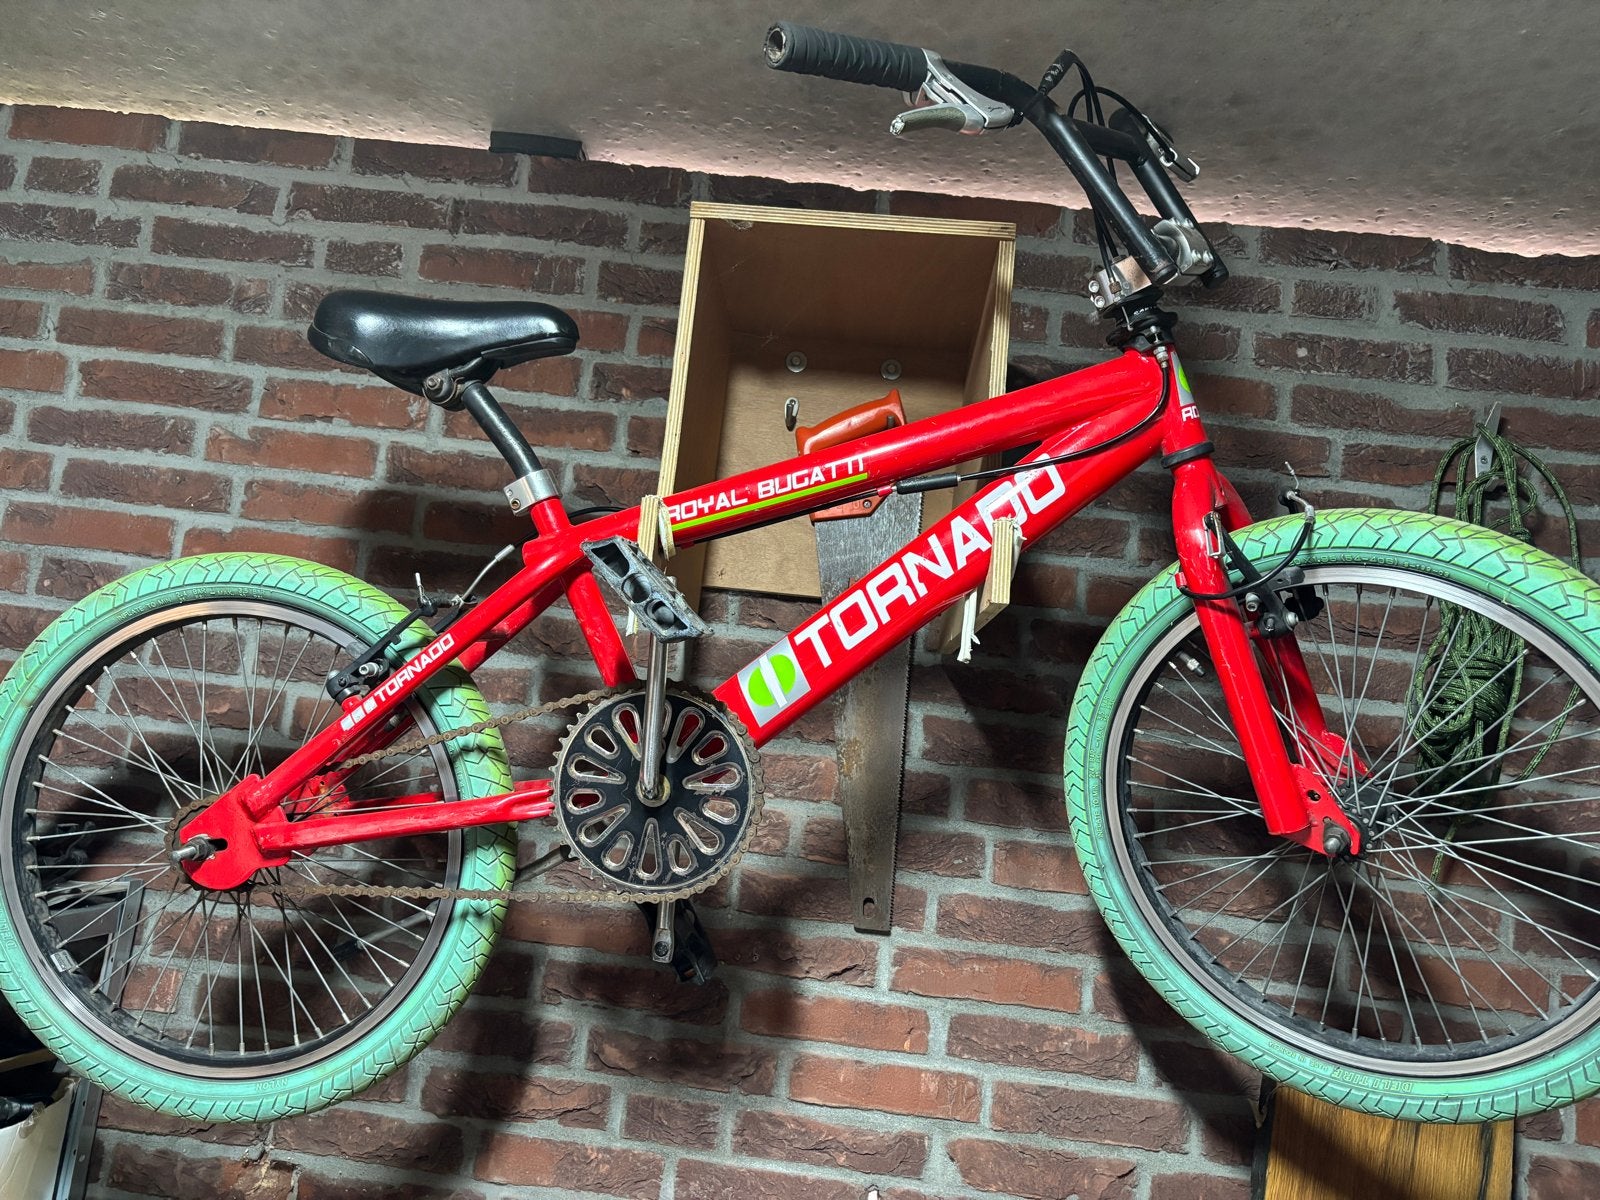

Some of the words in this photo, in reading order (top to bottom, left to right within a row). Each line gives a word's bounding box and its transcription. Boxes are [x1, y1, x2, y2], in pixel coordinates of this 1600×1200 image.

[668, 489, 748, 522] ROYAL
[757, 455, 866, 498] BUGATTI
[795, 453, 1066, 668] TORNADO
[374, 633, 455, 702] TORNADO
[256, 1078, 288, 1091] NYLON
[1331, 1069, 1368, 1086] TIRE
[1373, 1079, 1413, 1093] DELI
